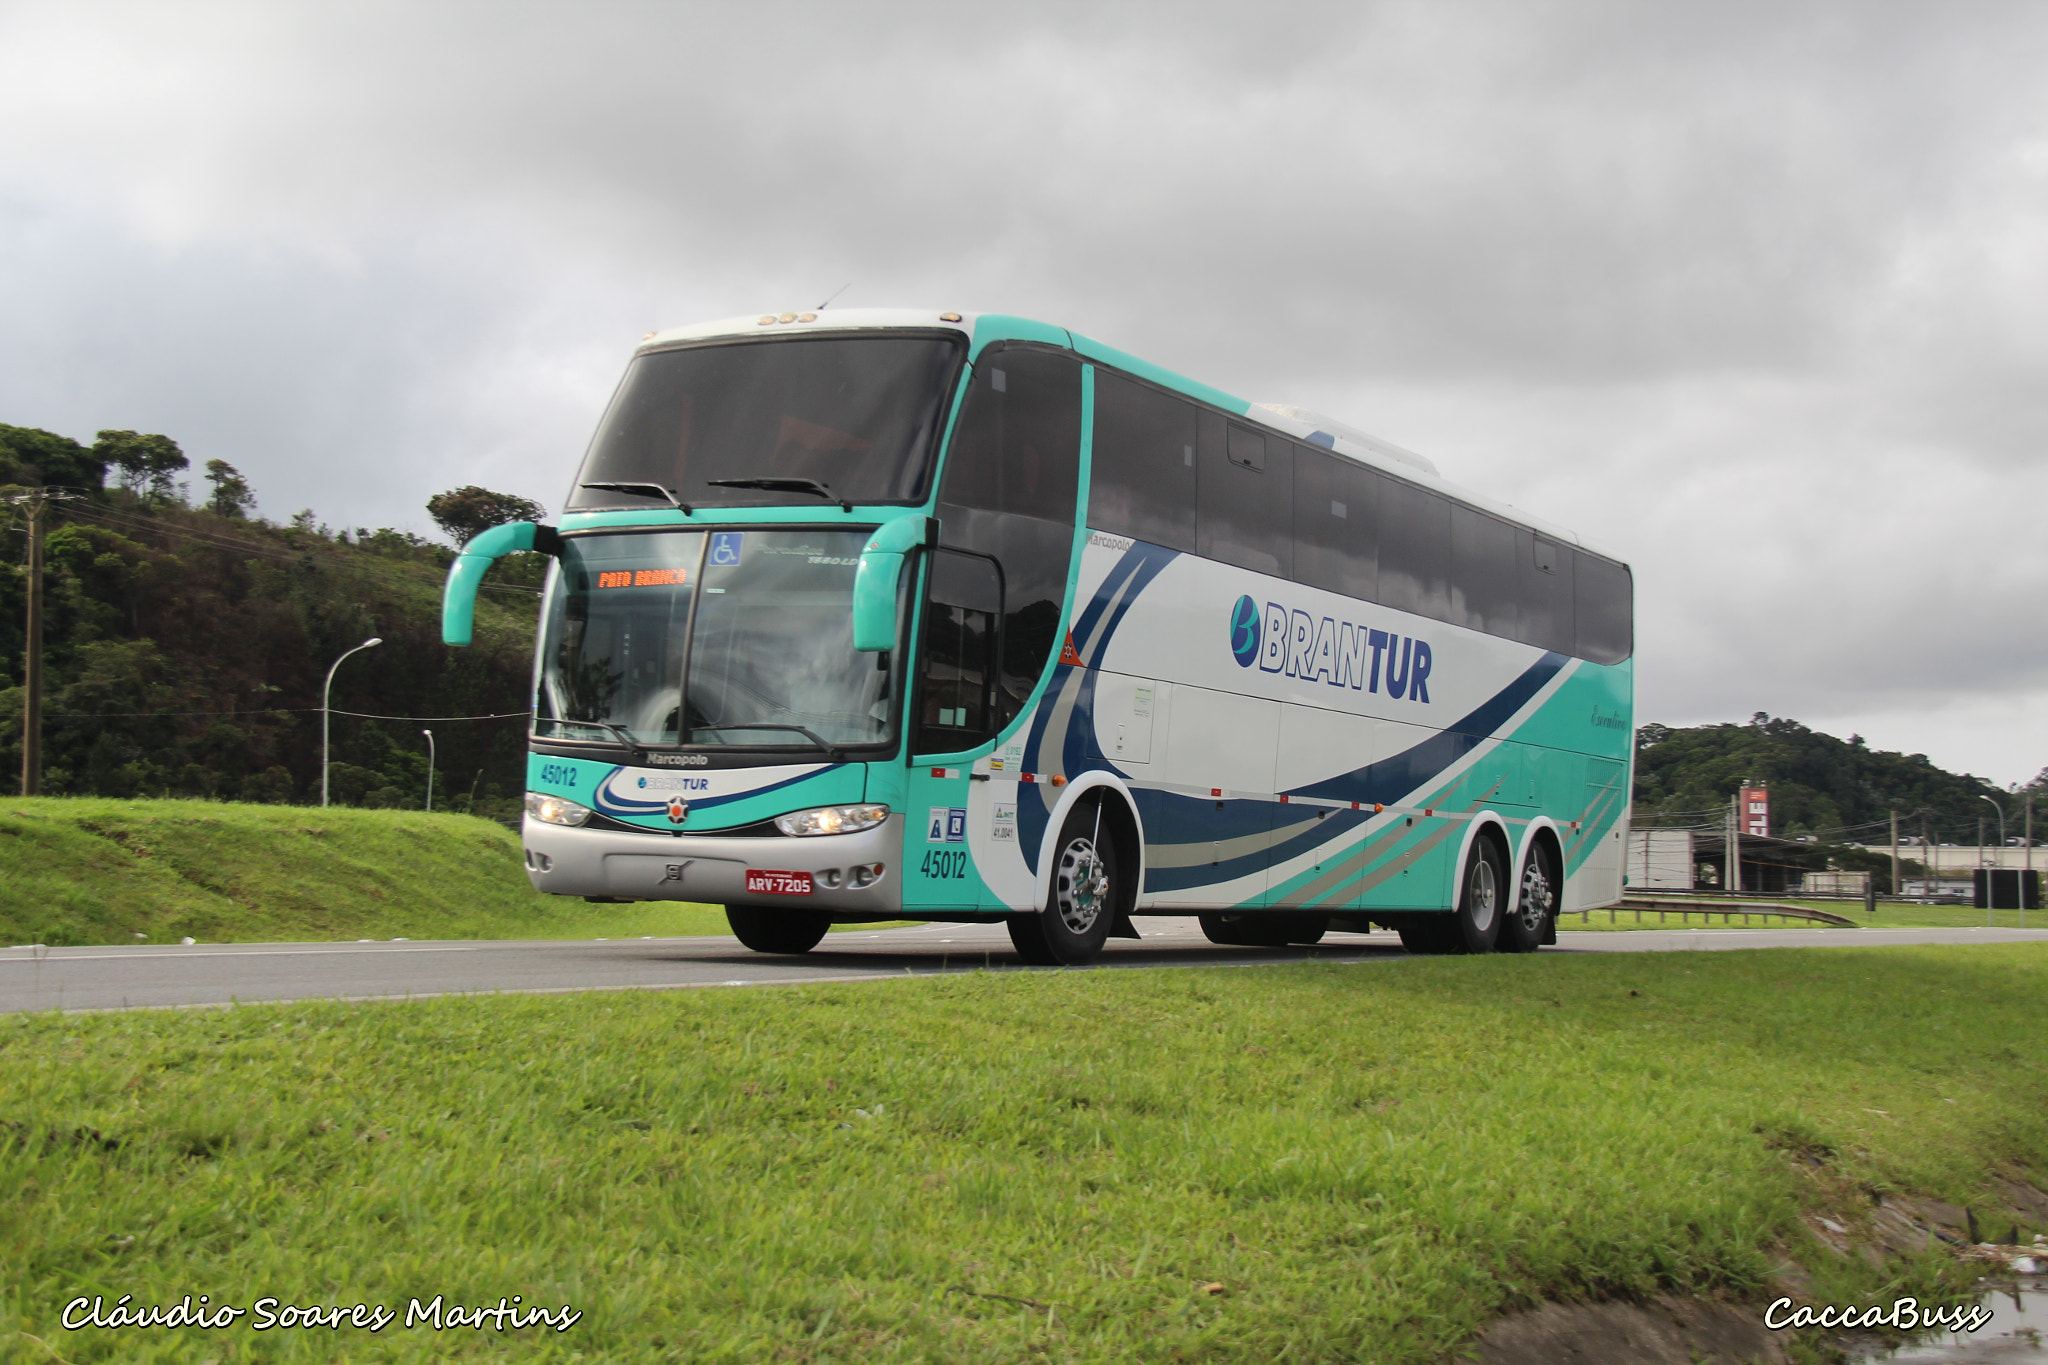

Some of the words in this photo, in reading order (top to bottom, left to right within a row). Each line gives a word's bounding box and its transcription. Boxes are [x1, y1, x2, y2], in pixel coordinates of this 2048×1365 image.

[1086, 531, 1130, 552] Marcopolo
[599, 571, 632, 588] PATO
[634, 568, 687, 586] BRANCO
[1259, 601, 1432, 704] BRANTUR
[646, 752, 708, 766] Marcopolo
[541, 763, 577, 787] 45012
[921, 850, 966, 879] 45012
[748, 877, 811, 893] ARV-7205
